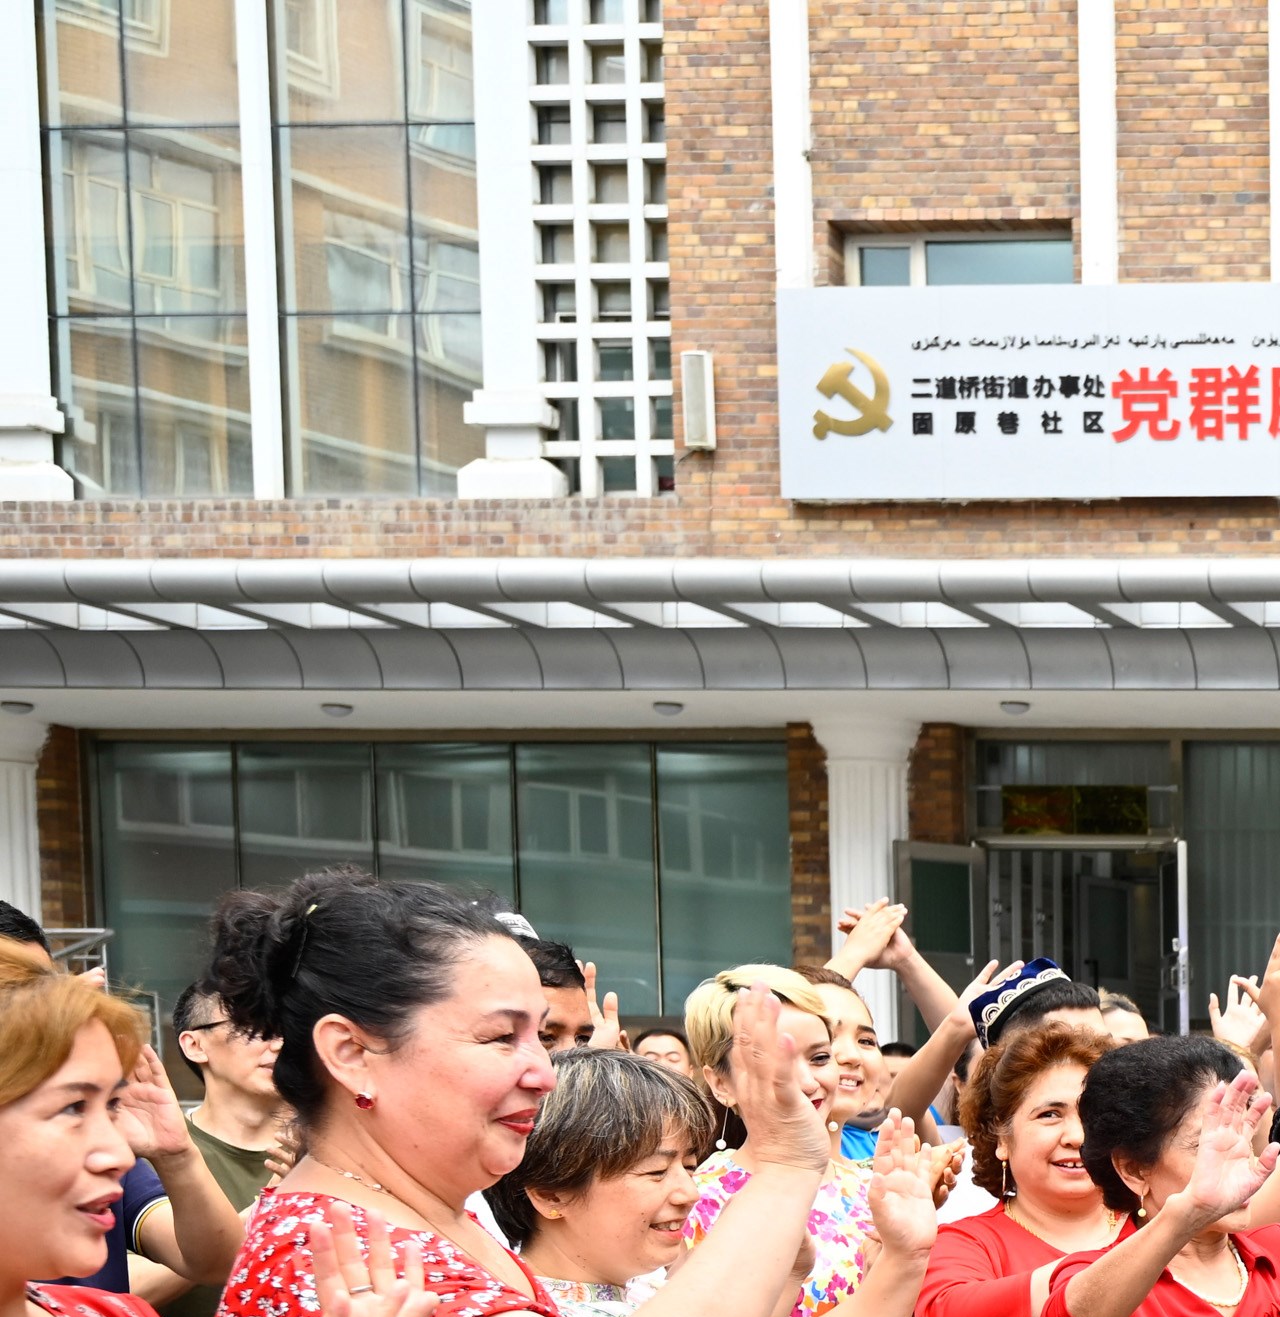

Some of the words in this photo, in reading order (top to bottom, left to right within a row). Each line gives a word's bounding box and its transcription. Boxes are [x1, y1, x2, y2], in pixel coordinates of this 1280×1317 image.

[911, 374, 1105, 399] 二道桥街道办事处
[912, 411, 1104, 435] 固原巷社区
